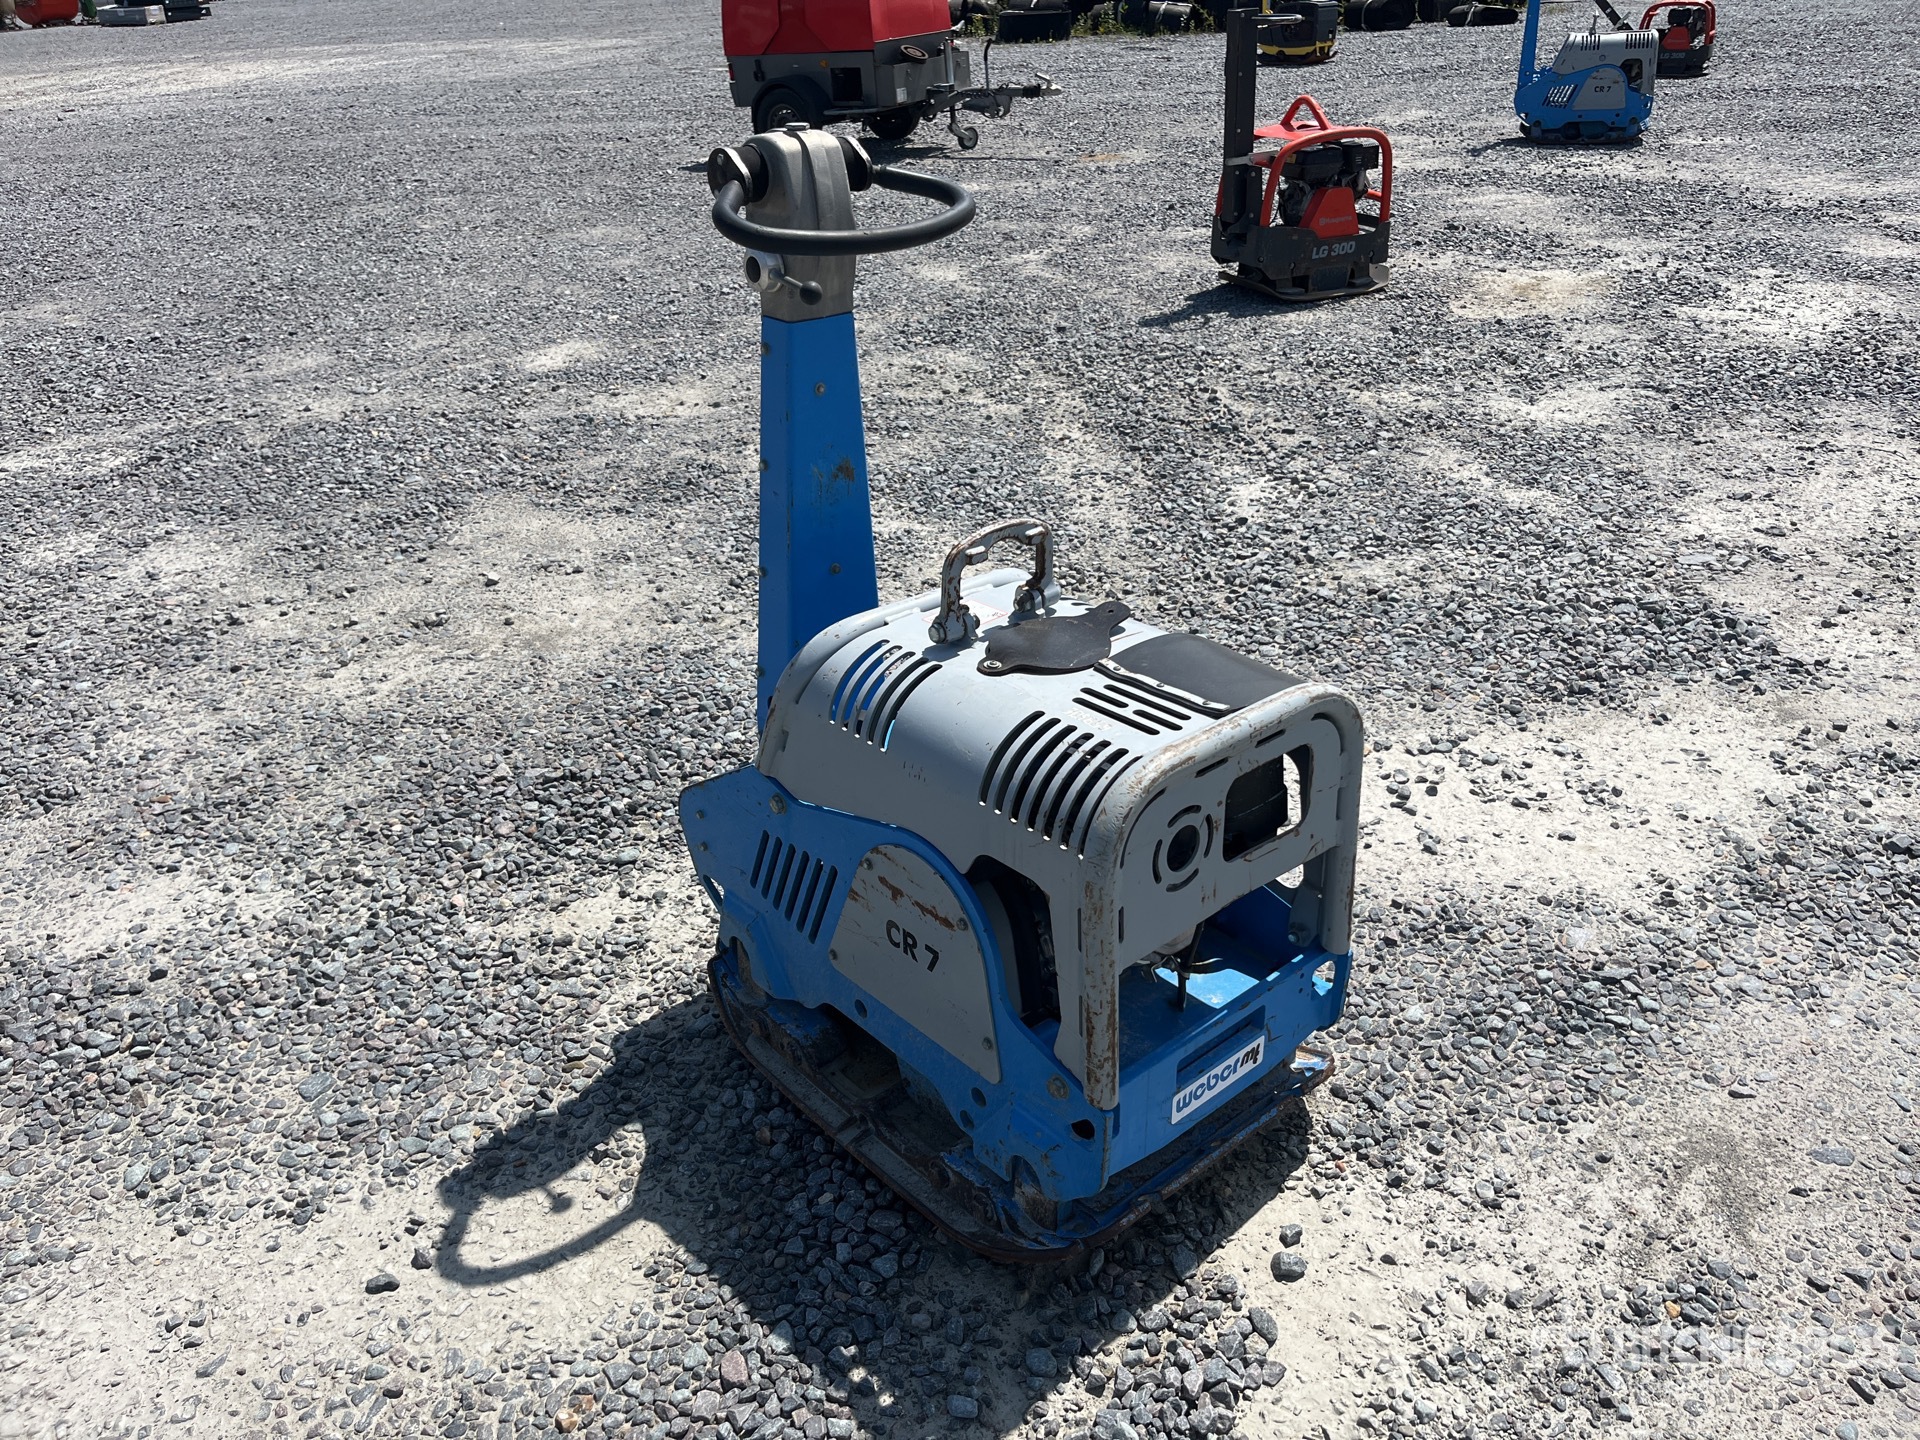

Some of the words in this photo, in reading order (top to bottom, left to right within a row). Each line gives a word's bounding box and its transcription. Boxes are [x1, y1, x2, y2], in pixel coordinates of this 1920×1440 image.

[1312, 245, 1329, 260] LG
[1331, 241, 1356, 256] 300
[886, 919, 919, 963] CR
[925, 944, 940, 972] 7
